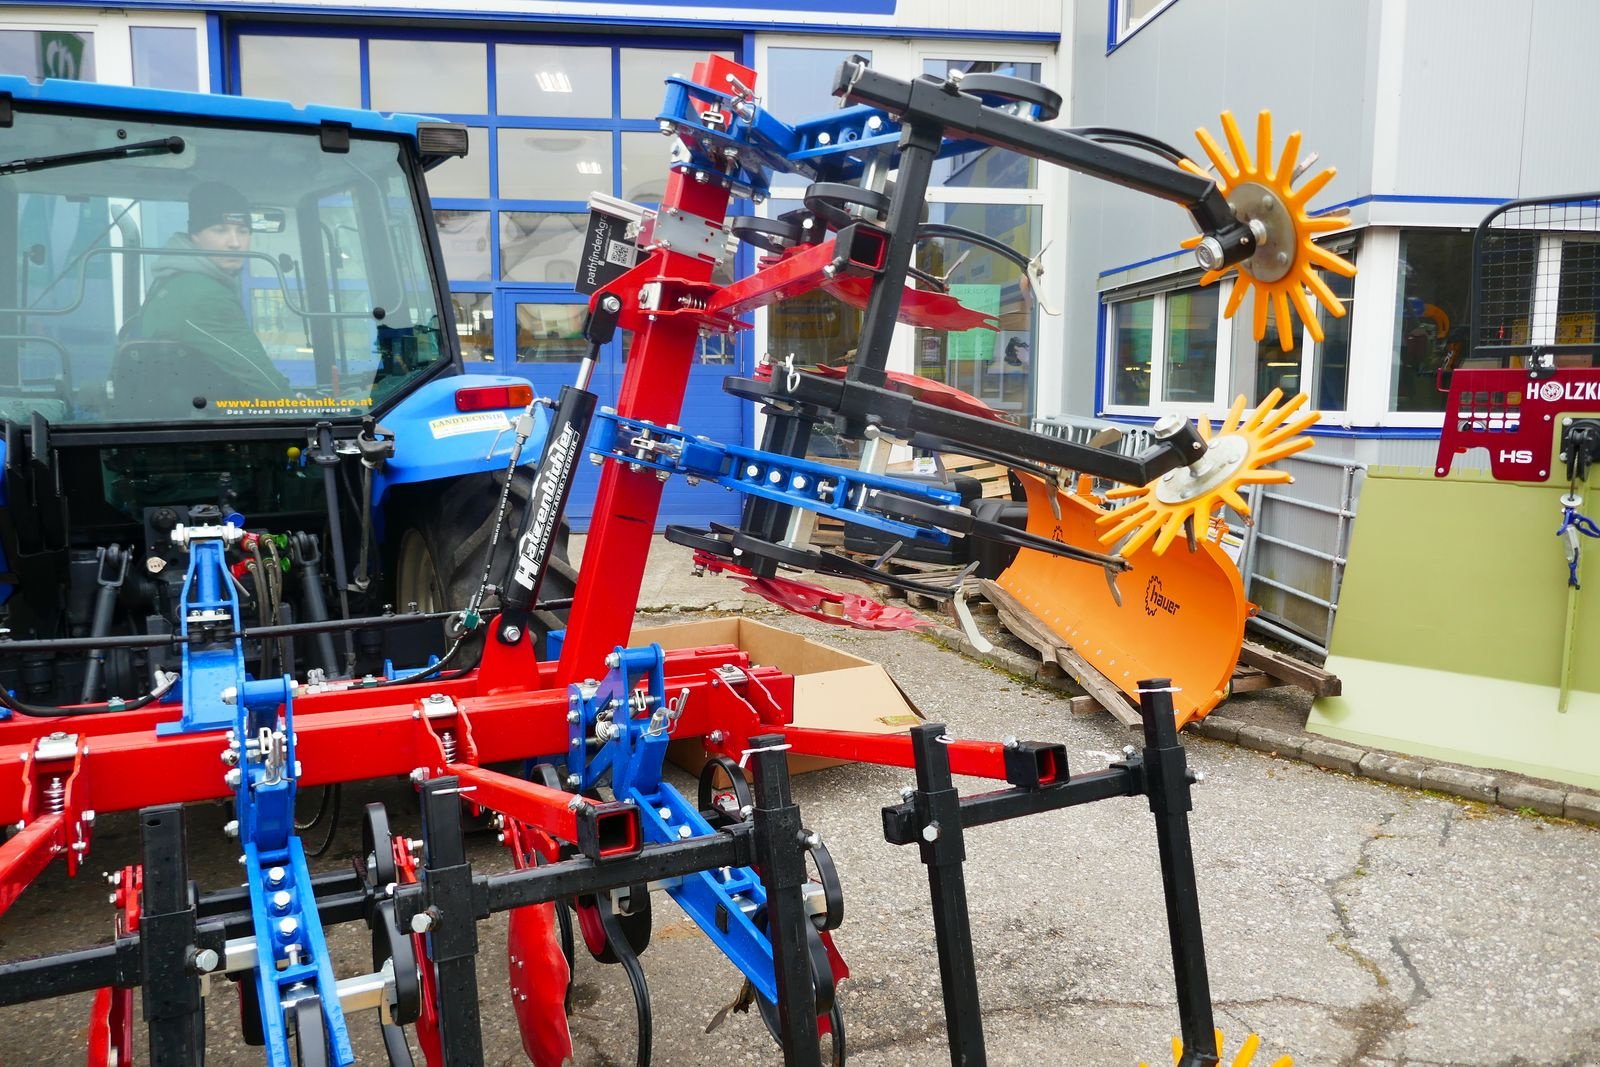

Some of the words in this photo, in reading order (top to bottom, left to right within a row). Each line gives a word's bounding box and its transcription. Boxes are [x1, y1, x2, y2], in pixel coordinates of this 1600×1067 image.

[1526, 381, 1600, 402] HOLZK
[215, 396, 373, 409] www.landtechnik.co.at
[274, 407, 299, 415] Ihres
[302, 406, 352, 414] Vertrauens
[431, 412, 504, 429] LANDTECHNIK
[1499, 449, 1533, 464] HS
[514, 420, 575, 591] Hatzenbichler
[1150, 584, 1181, 616] hauer
